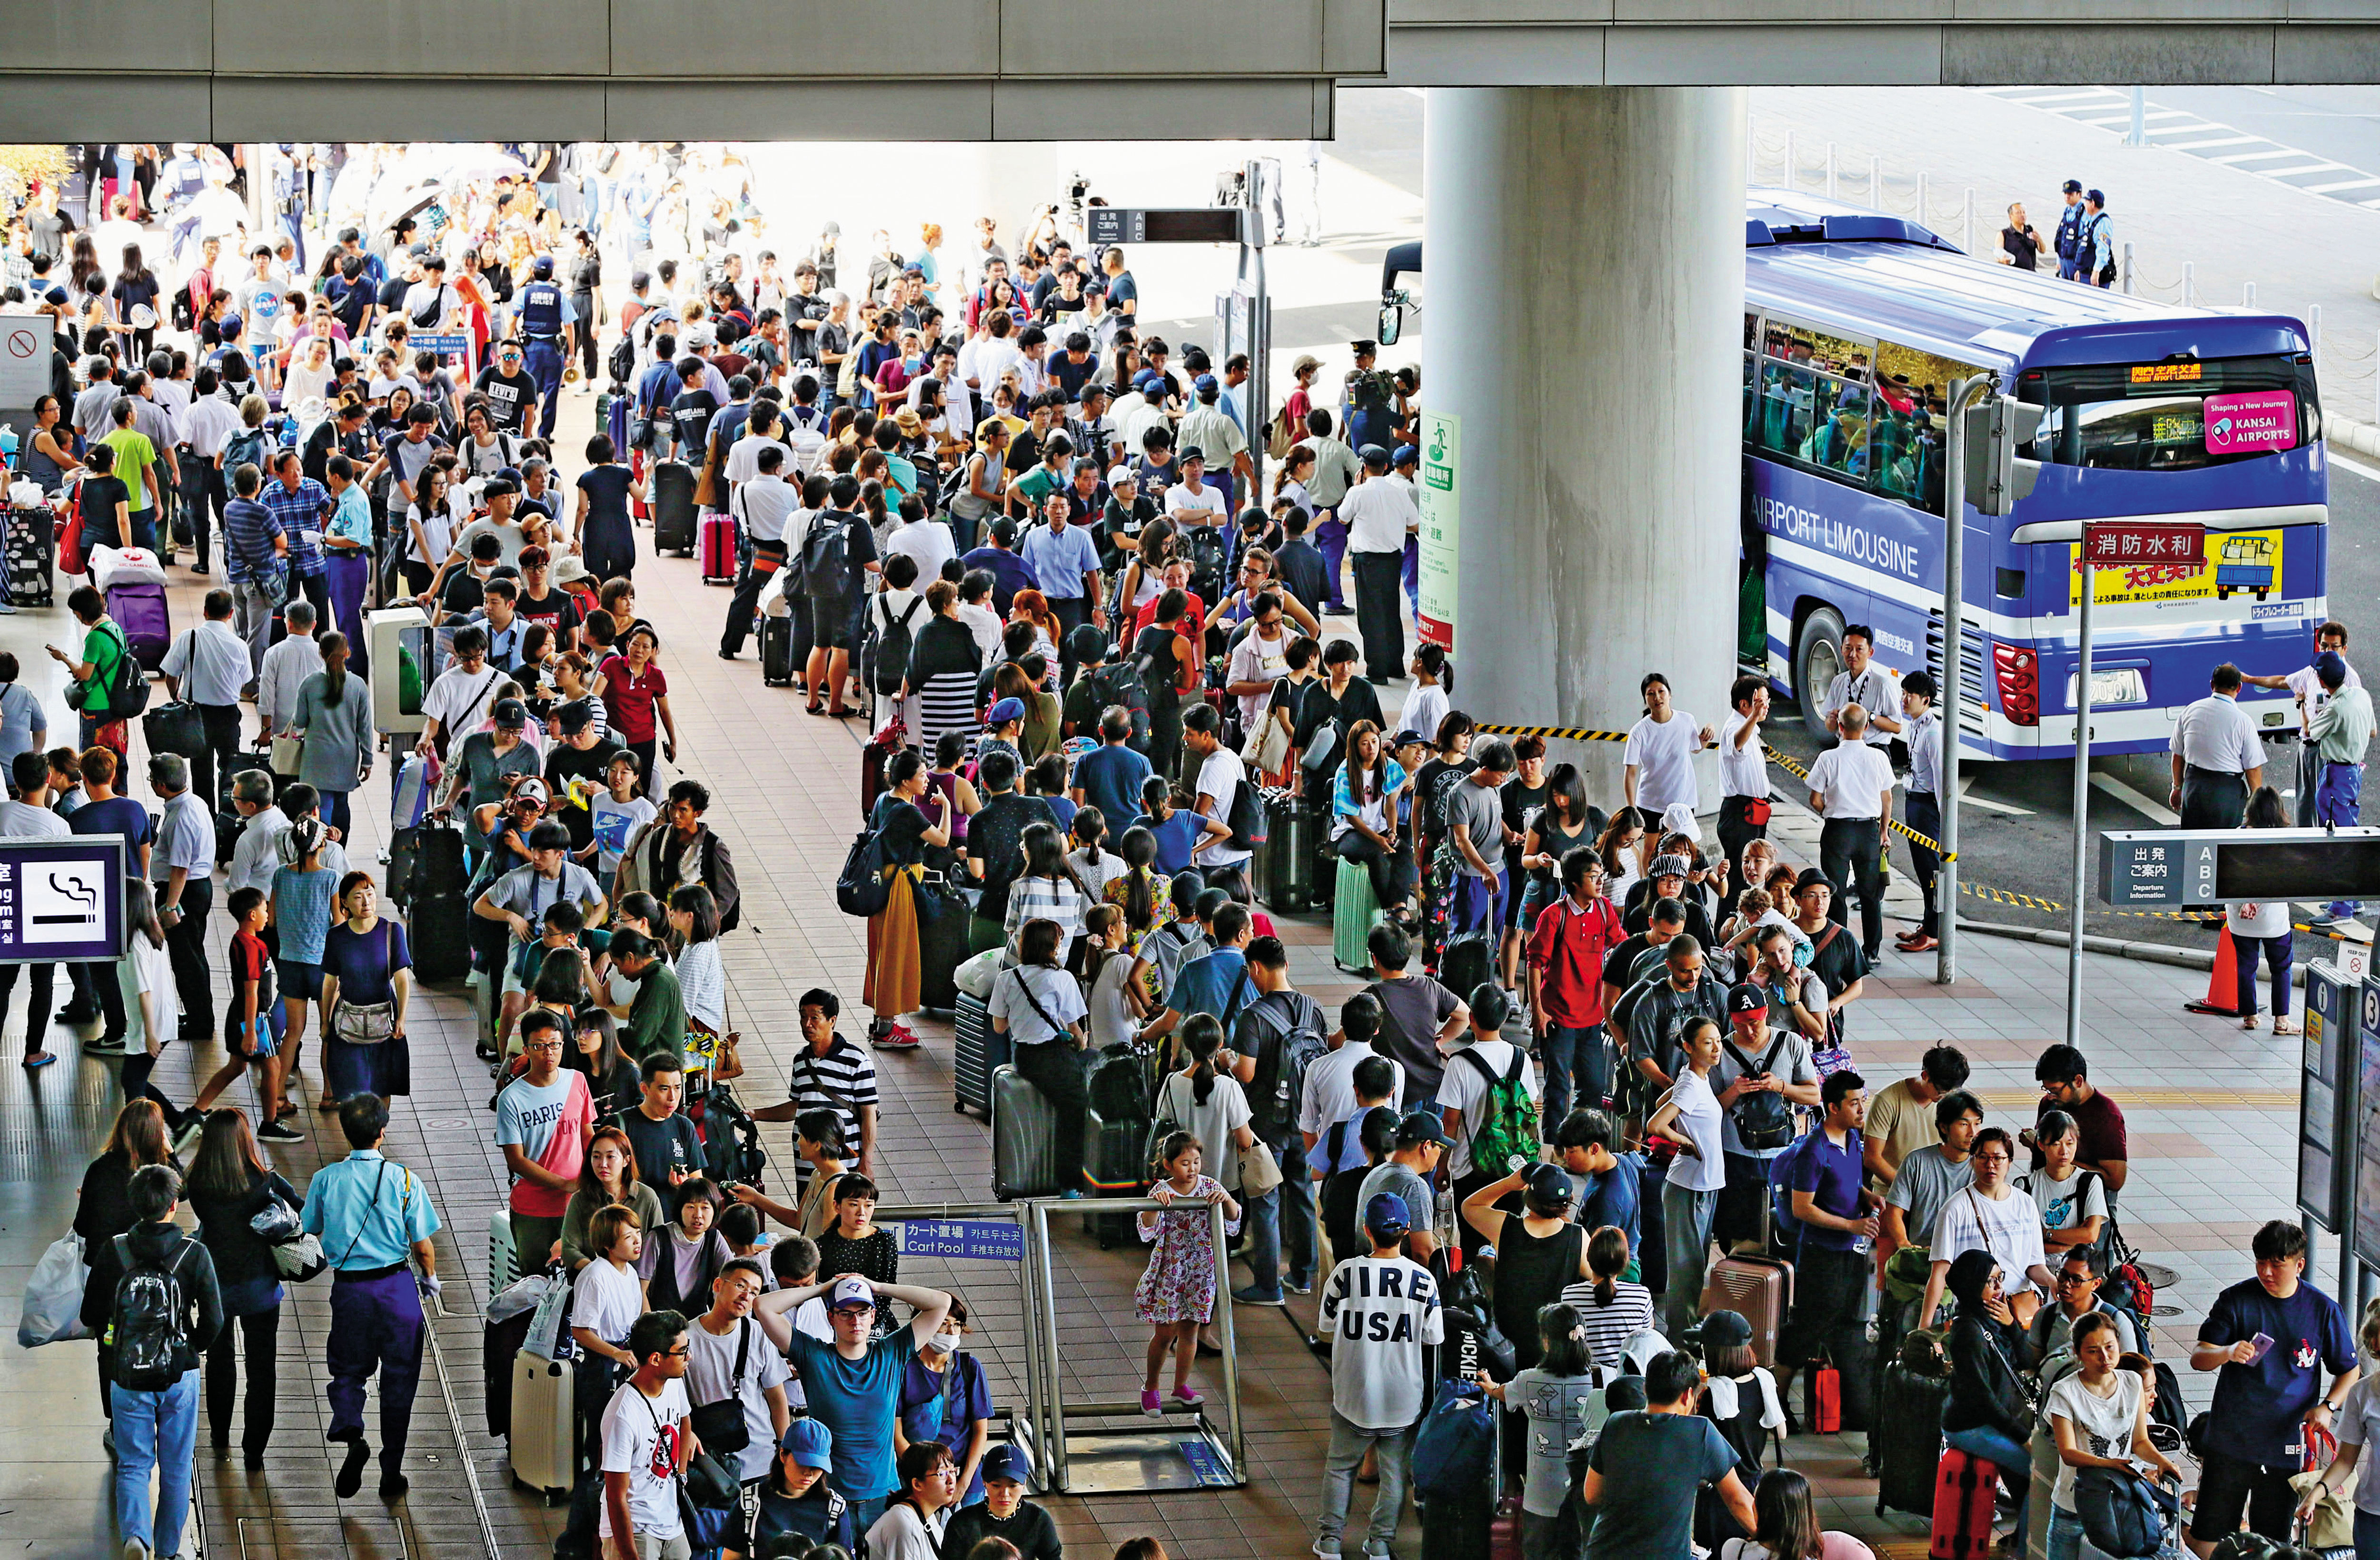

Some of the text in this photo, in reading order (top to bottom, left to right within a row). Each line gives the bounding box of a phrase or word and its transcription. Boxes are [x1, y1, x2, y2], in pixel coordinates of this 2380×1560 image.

[1135, 232, 1142, 240] C
[2211, 404, 2238, 412] Shaping
[2236, 417, 2276, 429] KANSAI
[2236, 429, 2291, 443] AIRPORTS
[1751, 494, 1919, 579] AIRPORT LIMOUSINE
[2096, 534, 2192, 556] 消防水利
[2135, 847, 2165, 861] 出発
[2200, 846, 2212, 861] A
[2131, 864, 2167, 877] ご案内
[2200, 865, 2211, 879] B
[2198, 884, 2211, 898] C
[2369, 992, 2378, 1024] 3
[521, 1102, 563, 1129] PARIS
[556, 1116, 581, 1136] TOKY
[908, 1224, 964, 1239] カート置場
[907, 1240, 964, 1255] Cart Pool
[970, 1243, 1021, 1258] 手推车存放处
[1342, 1310, 1413, 1343] USA
